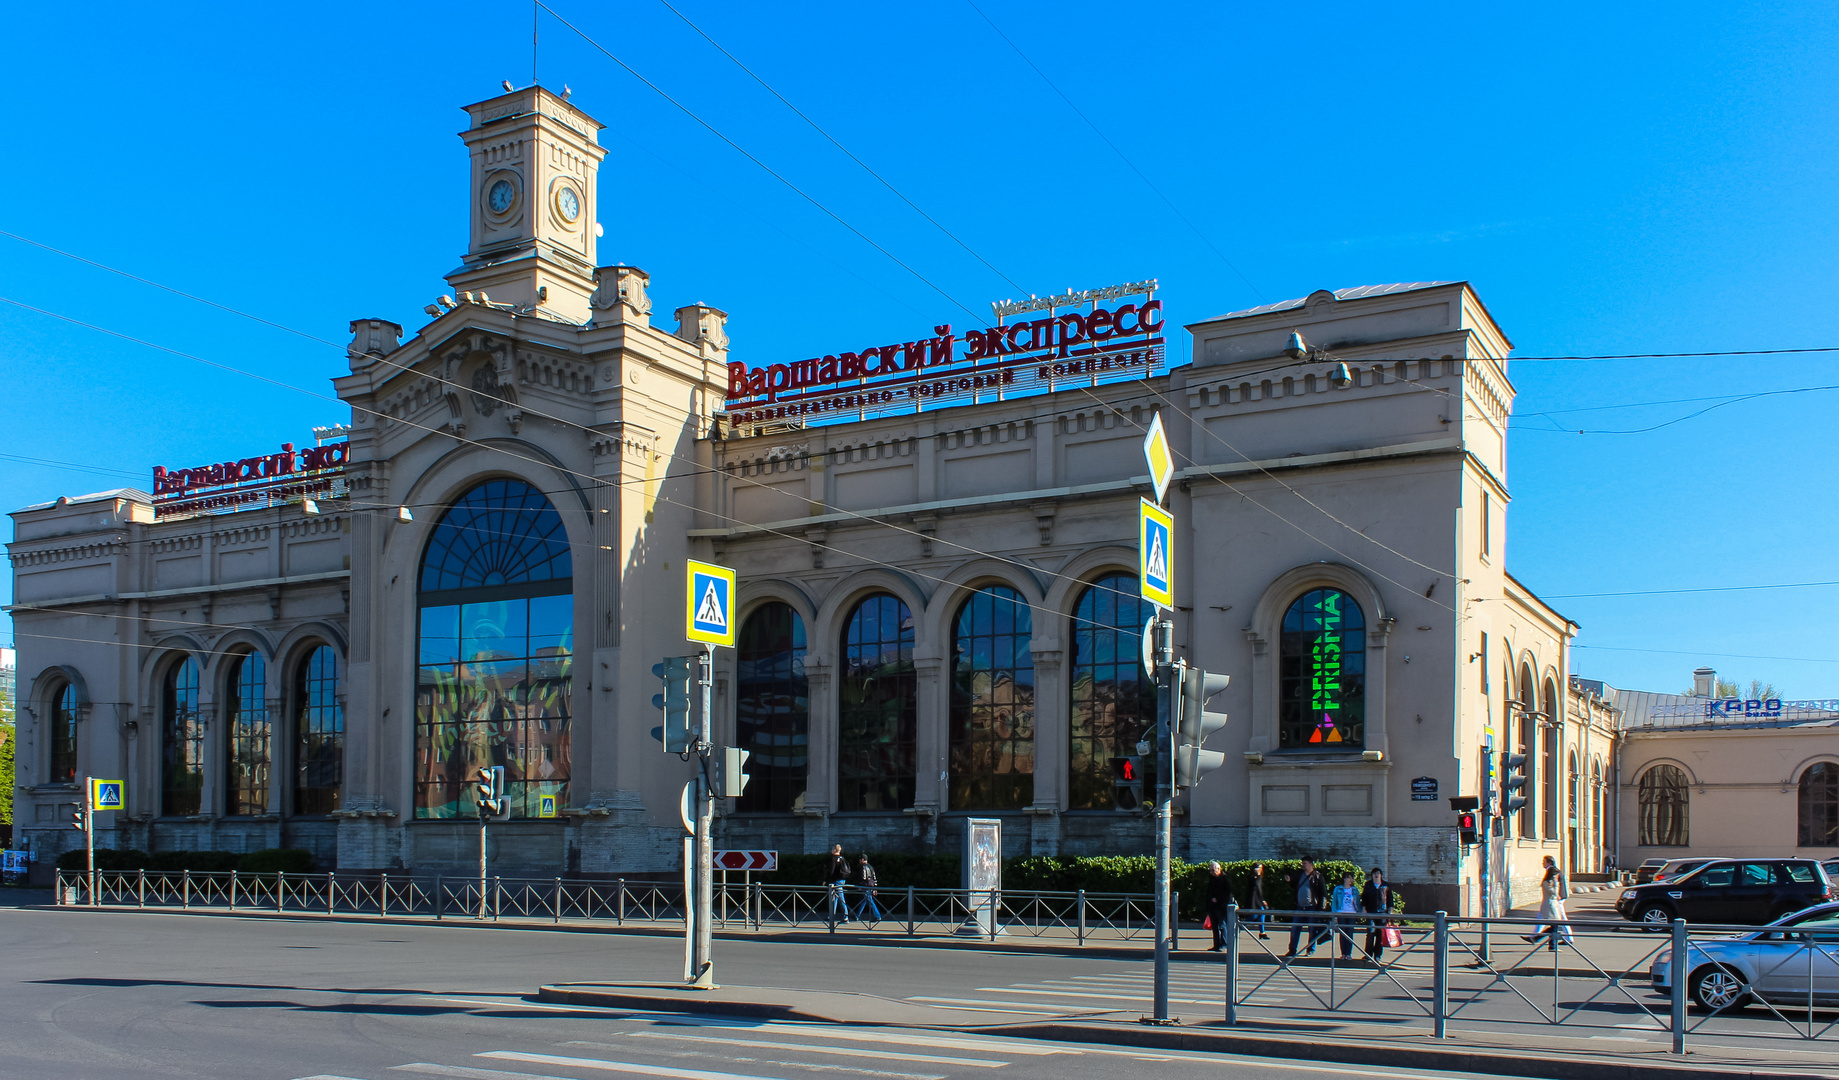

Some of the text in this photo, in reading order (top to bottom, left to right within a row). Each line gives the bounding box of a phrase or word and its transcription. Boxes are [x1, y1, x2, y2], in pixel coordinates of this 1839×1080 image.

[727, 300, 1165, 401] Варшавский экспресс
[1039, 350, 1157, 379] комплекс
[152, 442, 296, 498] Варшавский
[1312, 593, 1341, 710] PRISMA
